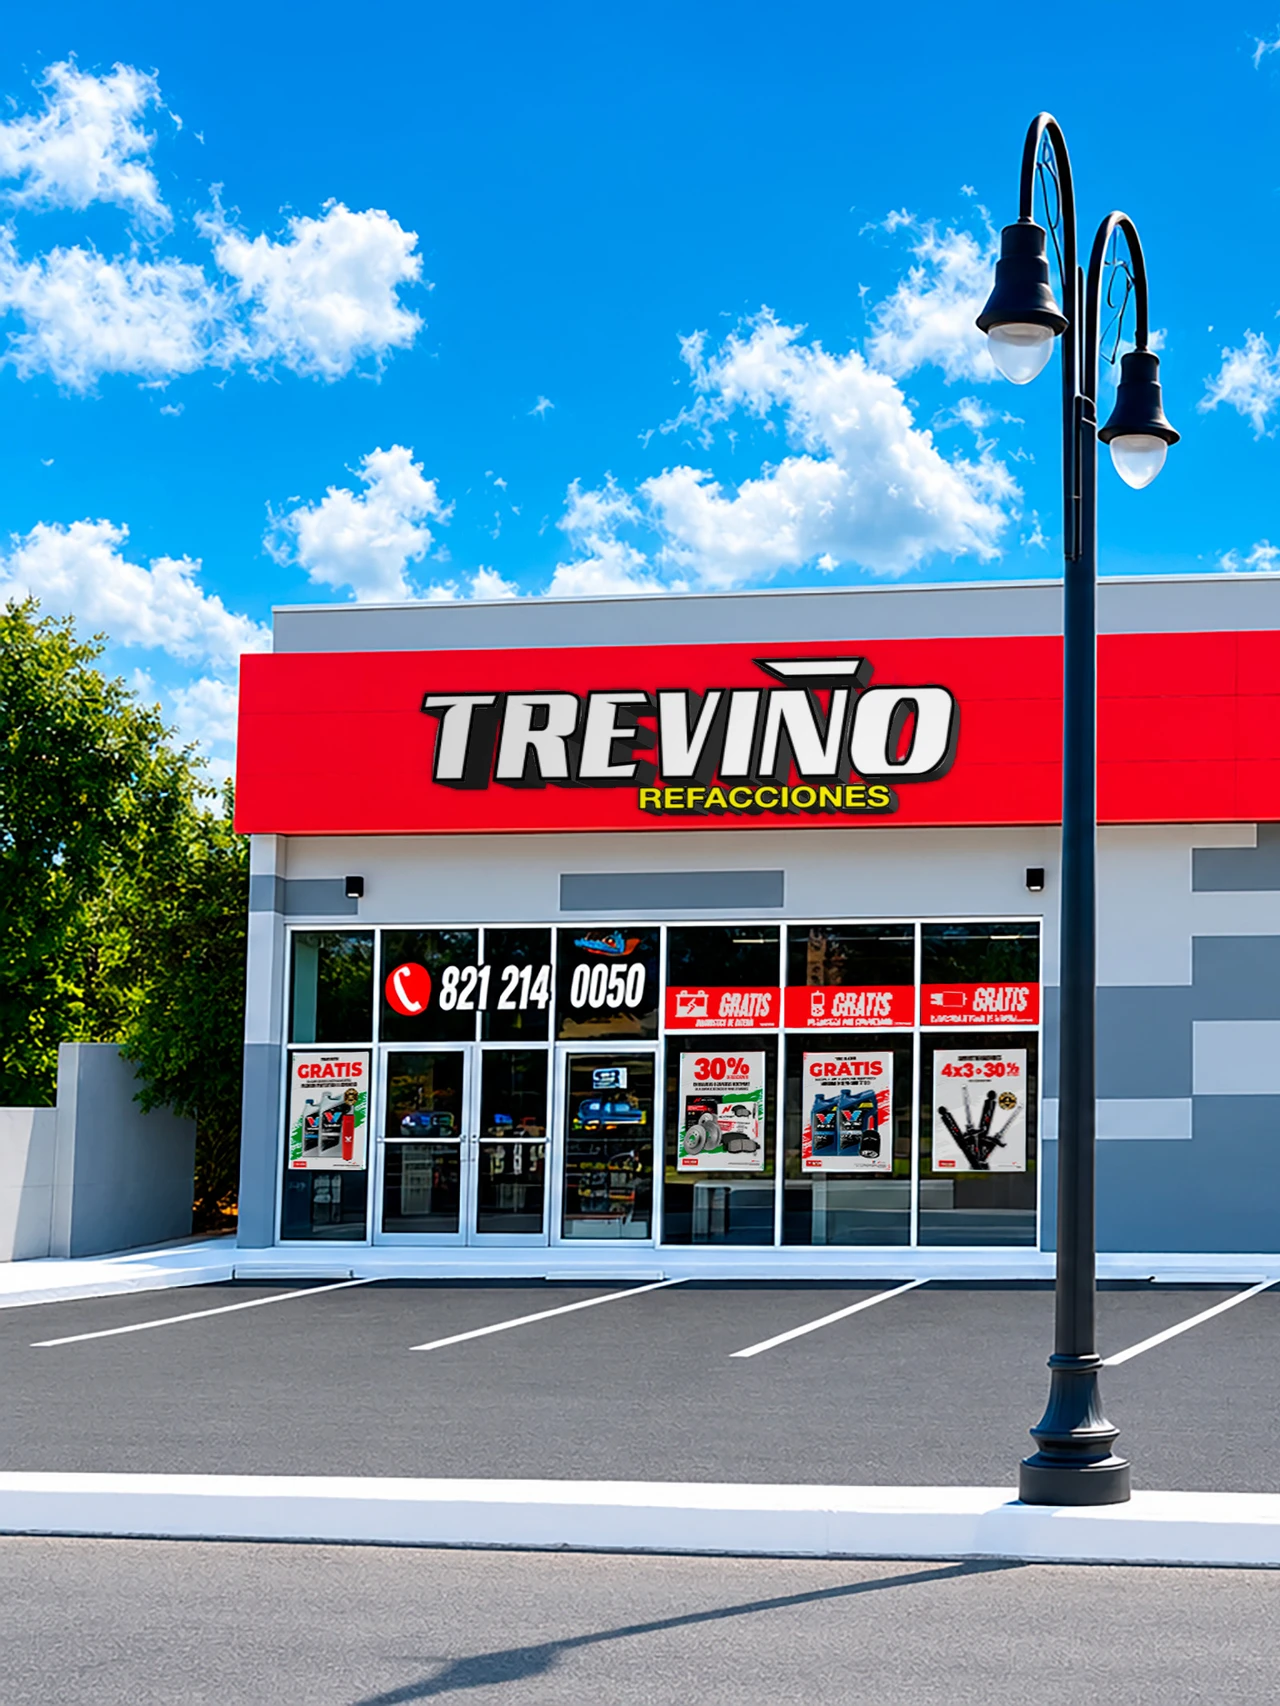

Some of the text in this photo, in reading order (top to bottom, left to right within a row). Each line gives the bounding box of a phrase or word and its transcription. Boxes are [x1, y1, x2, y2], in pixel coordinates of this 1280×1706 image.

[421, 656, 958, 786] TREVIÑO
[638, 784, 891, 811] REFACCIONES
[439, 963, 646, 1011] 821 214 0050
[972, 986, 1030, 1012] GRATIS
[718, 992, 772, 1017] GRATIS
[831, 992, 893, 1016] GRATIS
[297, 1061, 363, 1079] GRATIS
[694, 1057, 750, 1080] 30%
[809, 1061, 883, 1077] GRATIS
